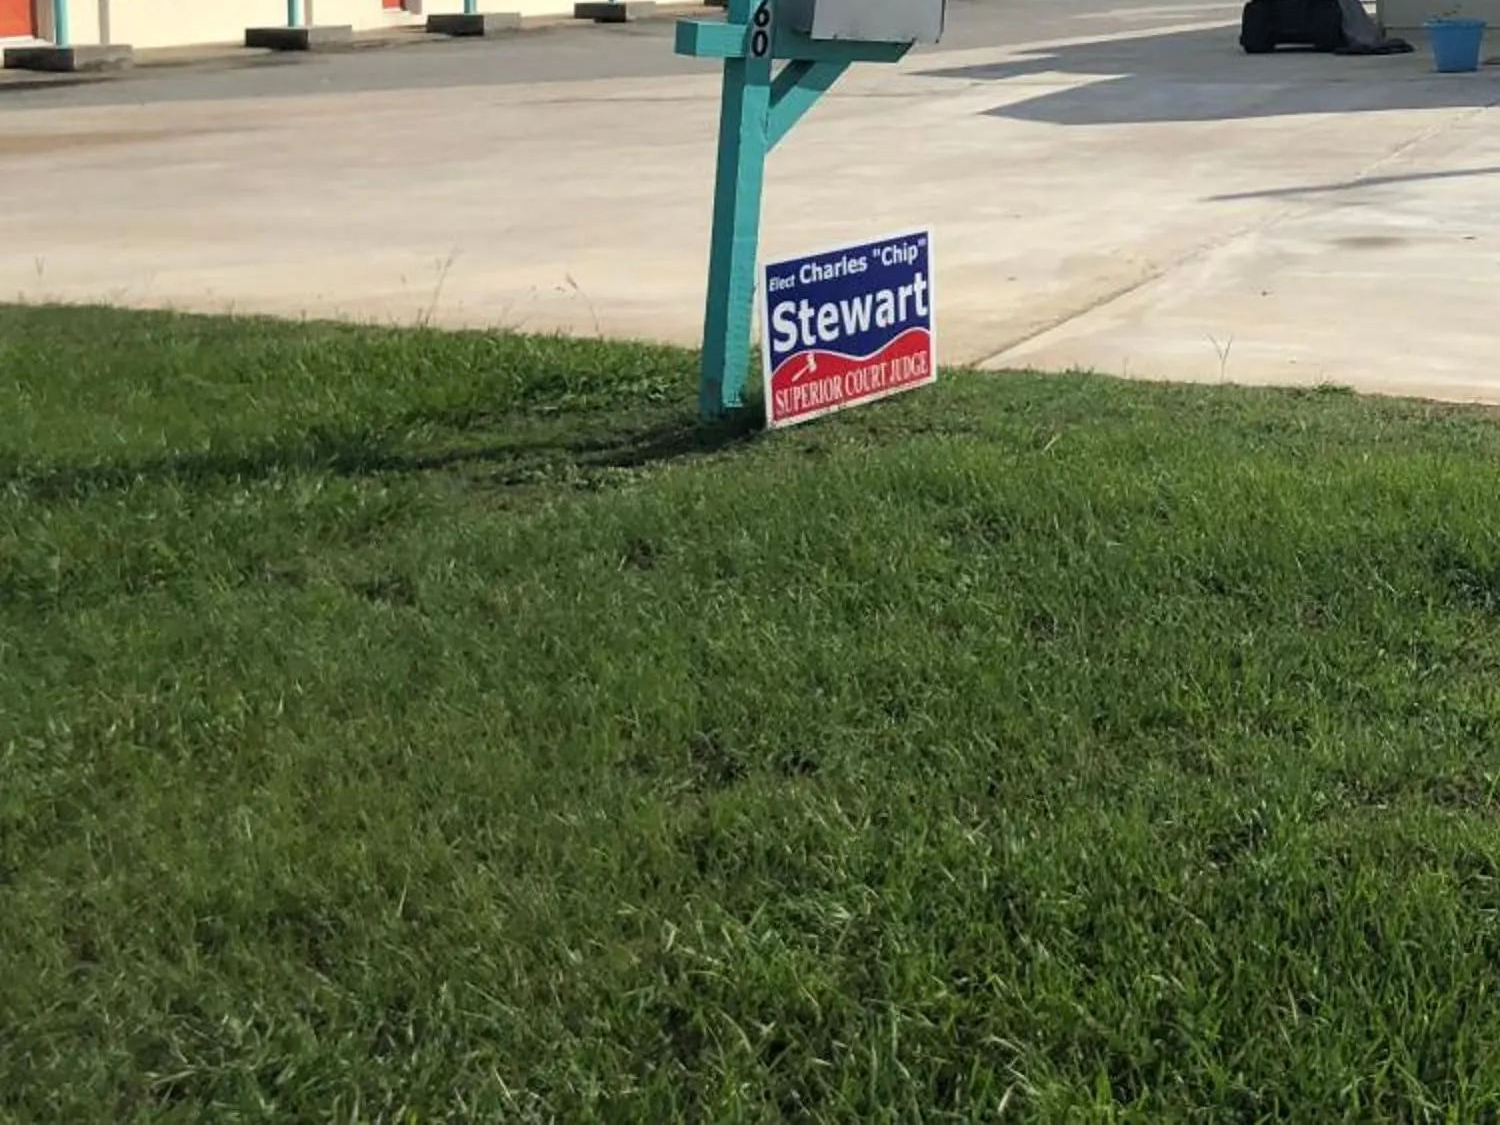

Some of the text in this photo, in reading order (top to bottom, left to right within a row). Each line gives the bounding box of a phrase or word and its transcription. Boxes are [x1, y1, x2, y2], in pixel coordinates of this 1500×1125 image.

[769, 238, 927, 291] Elect Charles "Chip"
[772, 272, 929, 353] Stewart
[775, 350, 929, 414] SUPERIOR COURT JUDGE
